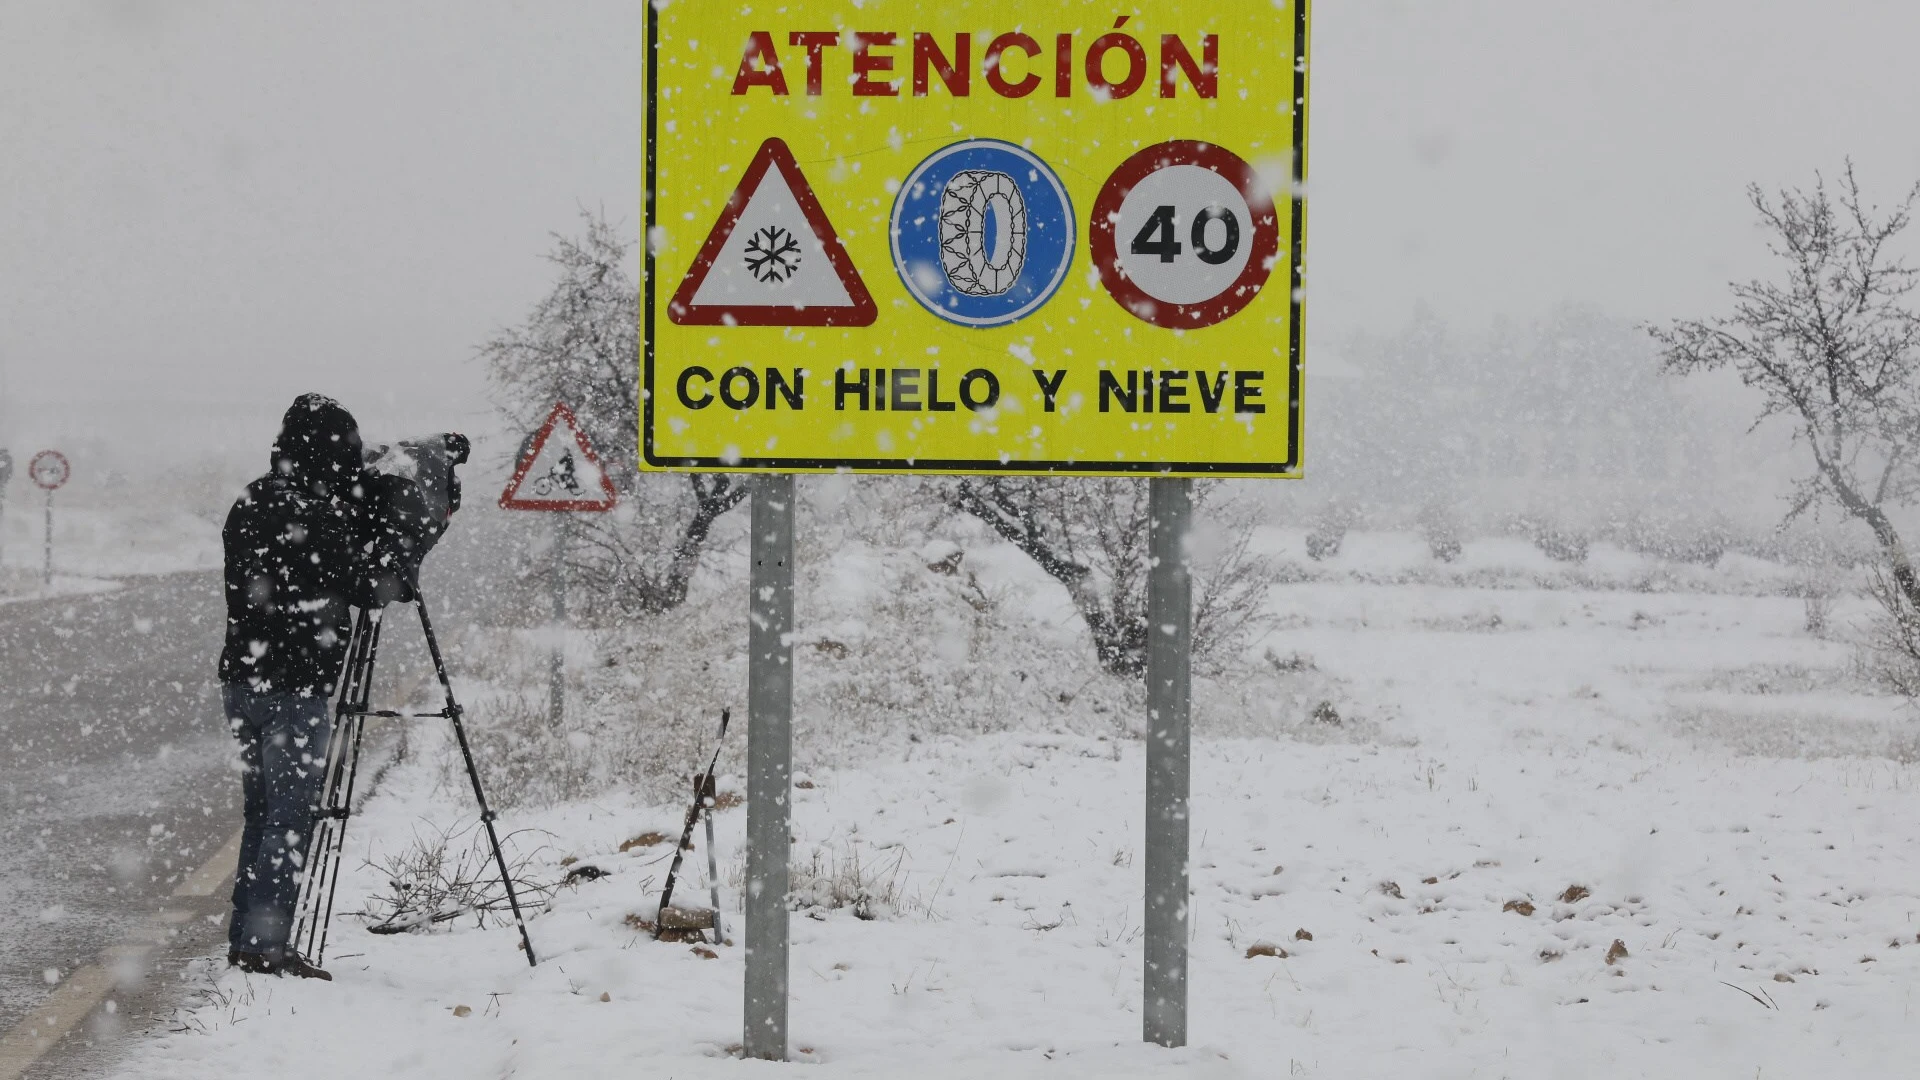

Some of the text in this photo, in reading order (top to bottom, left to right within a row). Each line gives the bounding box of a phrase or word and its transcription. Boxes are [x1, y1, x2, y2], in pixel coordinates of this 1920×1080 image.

[731, 16, 1220, 99] ATENCIÓN
[1131, 205, 1240, 264] 40
[676, 366, 1266, 413] CON HIELO Y NIEVE
